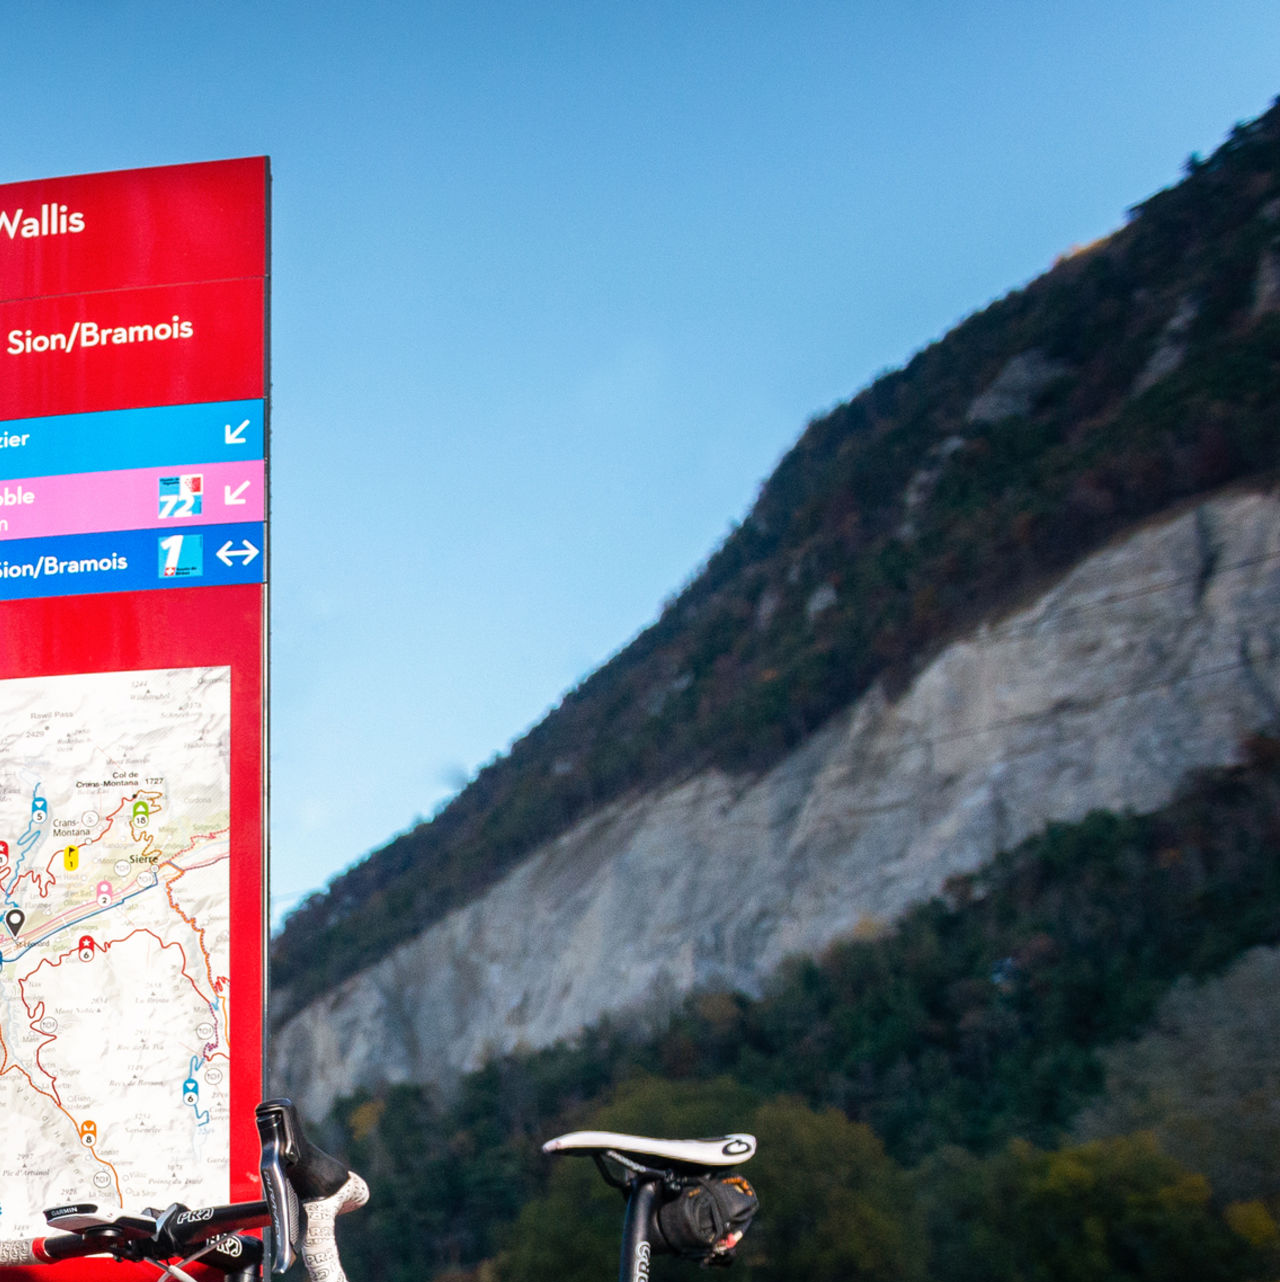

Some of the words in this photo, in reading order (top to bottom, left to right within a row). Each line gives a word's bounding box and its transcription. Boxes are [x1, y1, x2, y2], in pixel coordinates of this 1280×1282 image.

[7, 315, 194, 356] Sion/Bramois
[158, 494, 195, 519] 72
[160, 534, 184, 568] 1
[112, 771, 127, 779] Col
[52, 819, 79, 828] Crans-
[52, 828, 91, 838] Montana
[129, 854, 159, 864] Sierre
[83, 951, 90, 959] 6
[86, 1136, 92, 1144] 8
[51, 1207, 78, 1217] GARMIN
